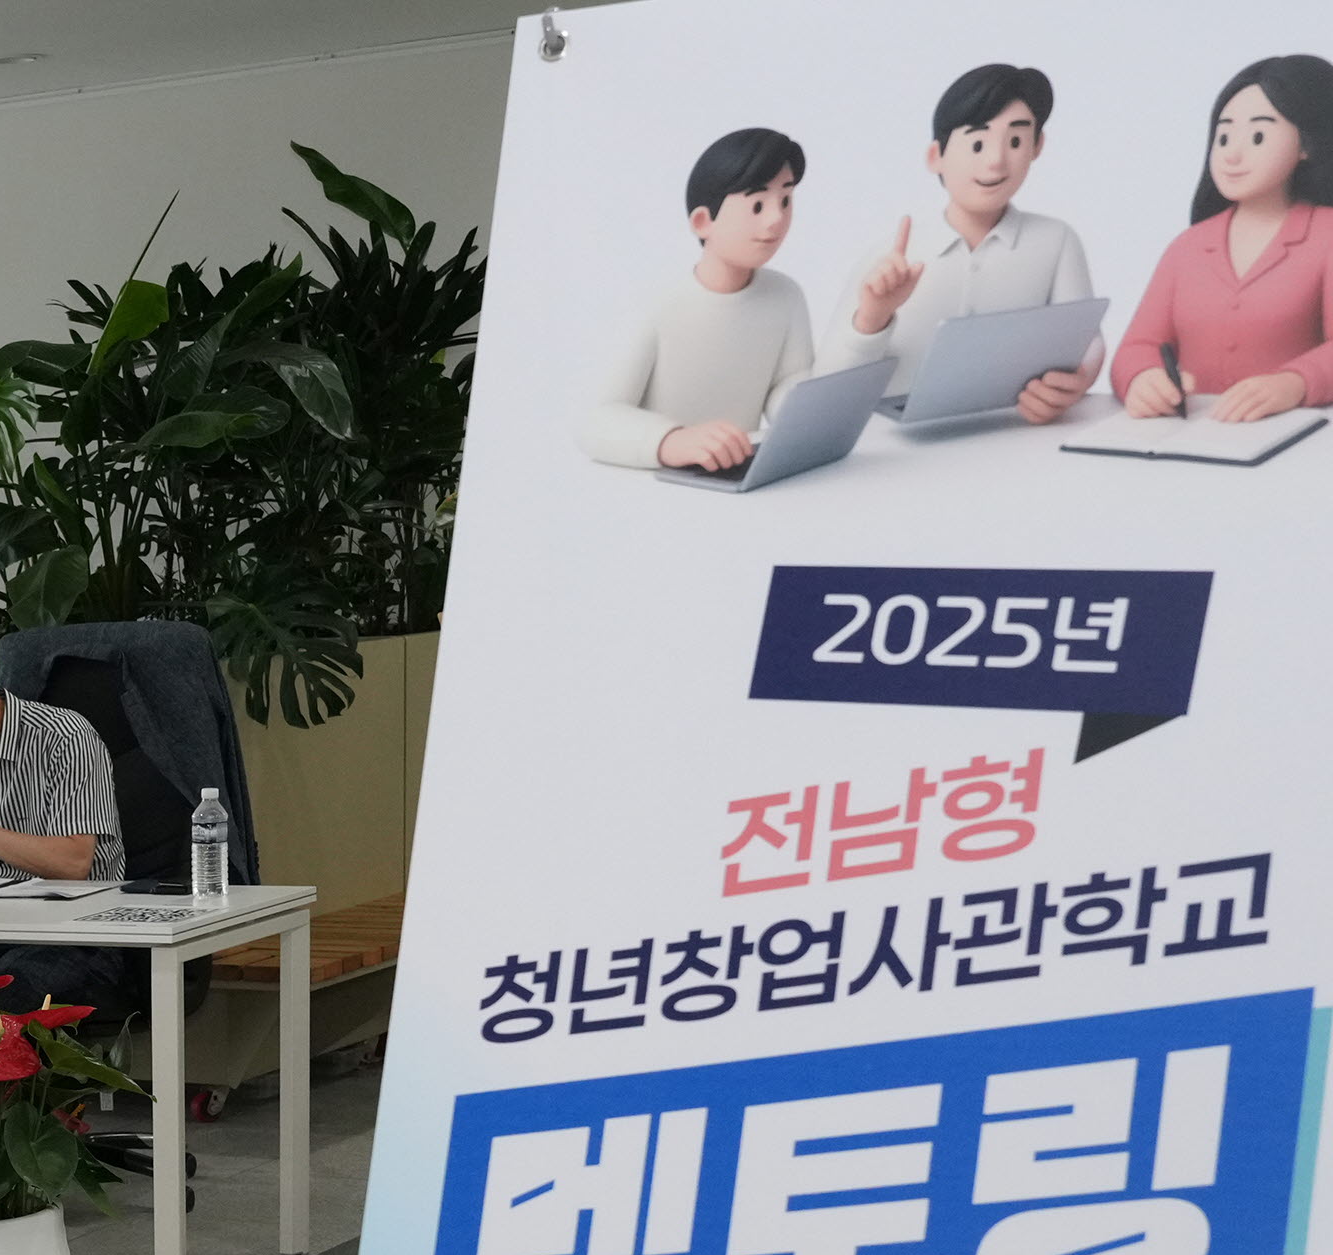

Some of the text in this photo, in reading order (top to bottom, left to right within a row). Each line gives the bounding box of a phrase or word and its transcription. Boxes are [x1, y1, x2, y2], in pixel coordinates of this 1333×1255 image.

[812, 592, 1130, 674] 2025년
[719, 746, 1047, 899] 전남형
[479, 851, 1273, 1044] 청년창업사관학교
